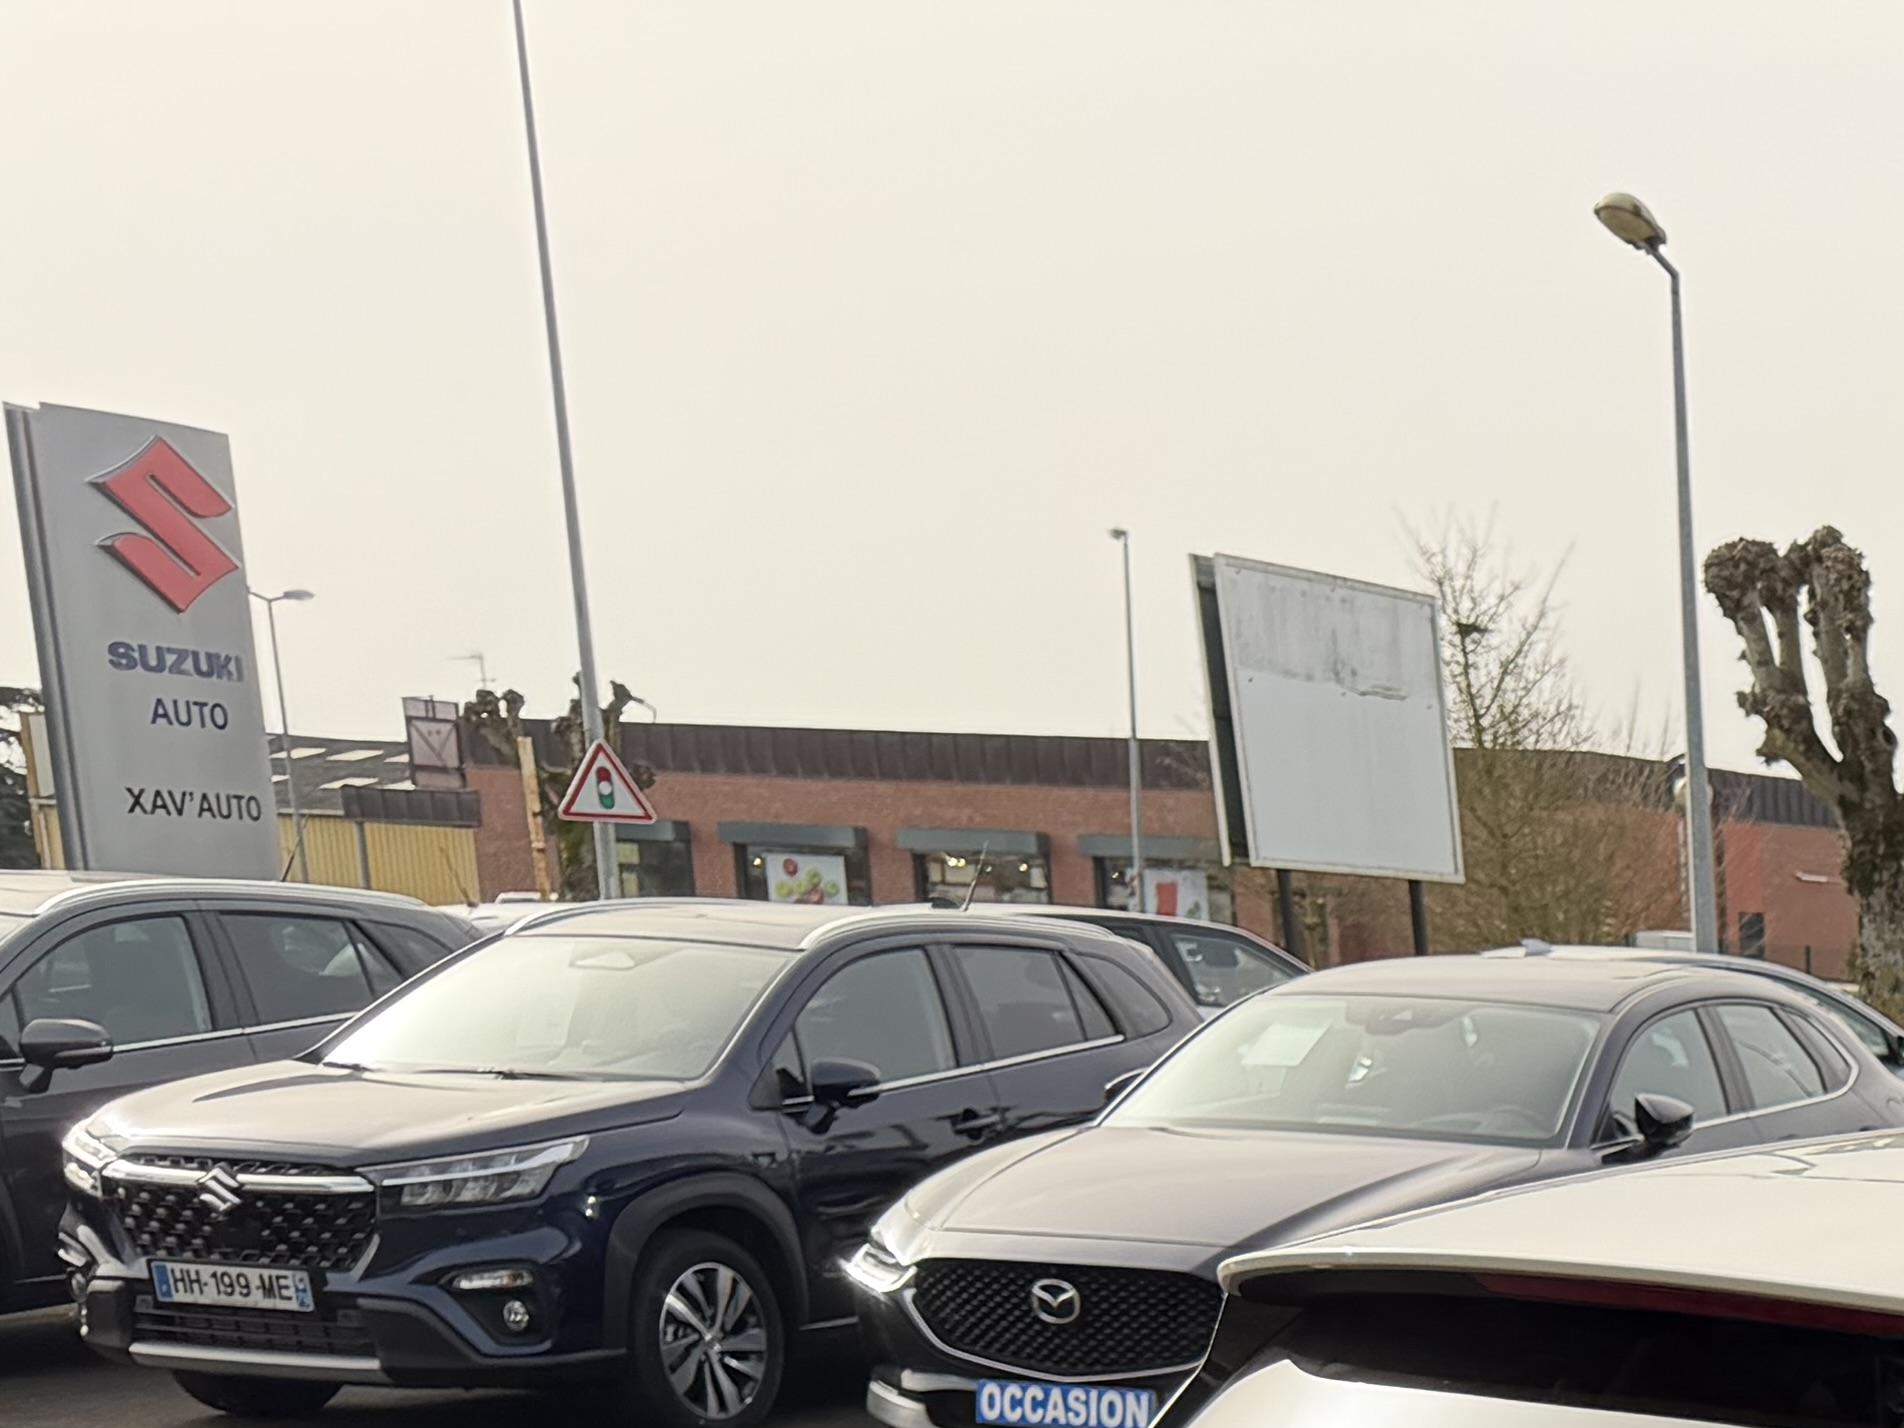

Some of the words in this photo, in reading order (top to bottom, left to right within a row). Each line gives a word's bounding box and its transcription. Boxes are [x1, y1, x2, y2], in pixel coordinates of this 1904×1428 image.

[107, 641, 244, 682] SUZUKI
[151, 698, 229, 730] AUTO
[125, 786, 262, 822] XAV'AUTO
[170, 1268, 293, 1301] HH-199-ME
